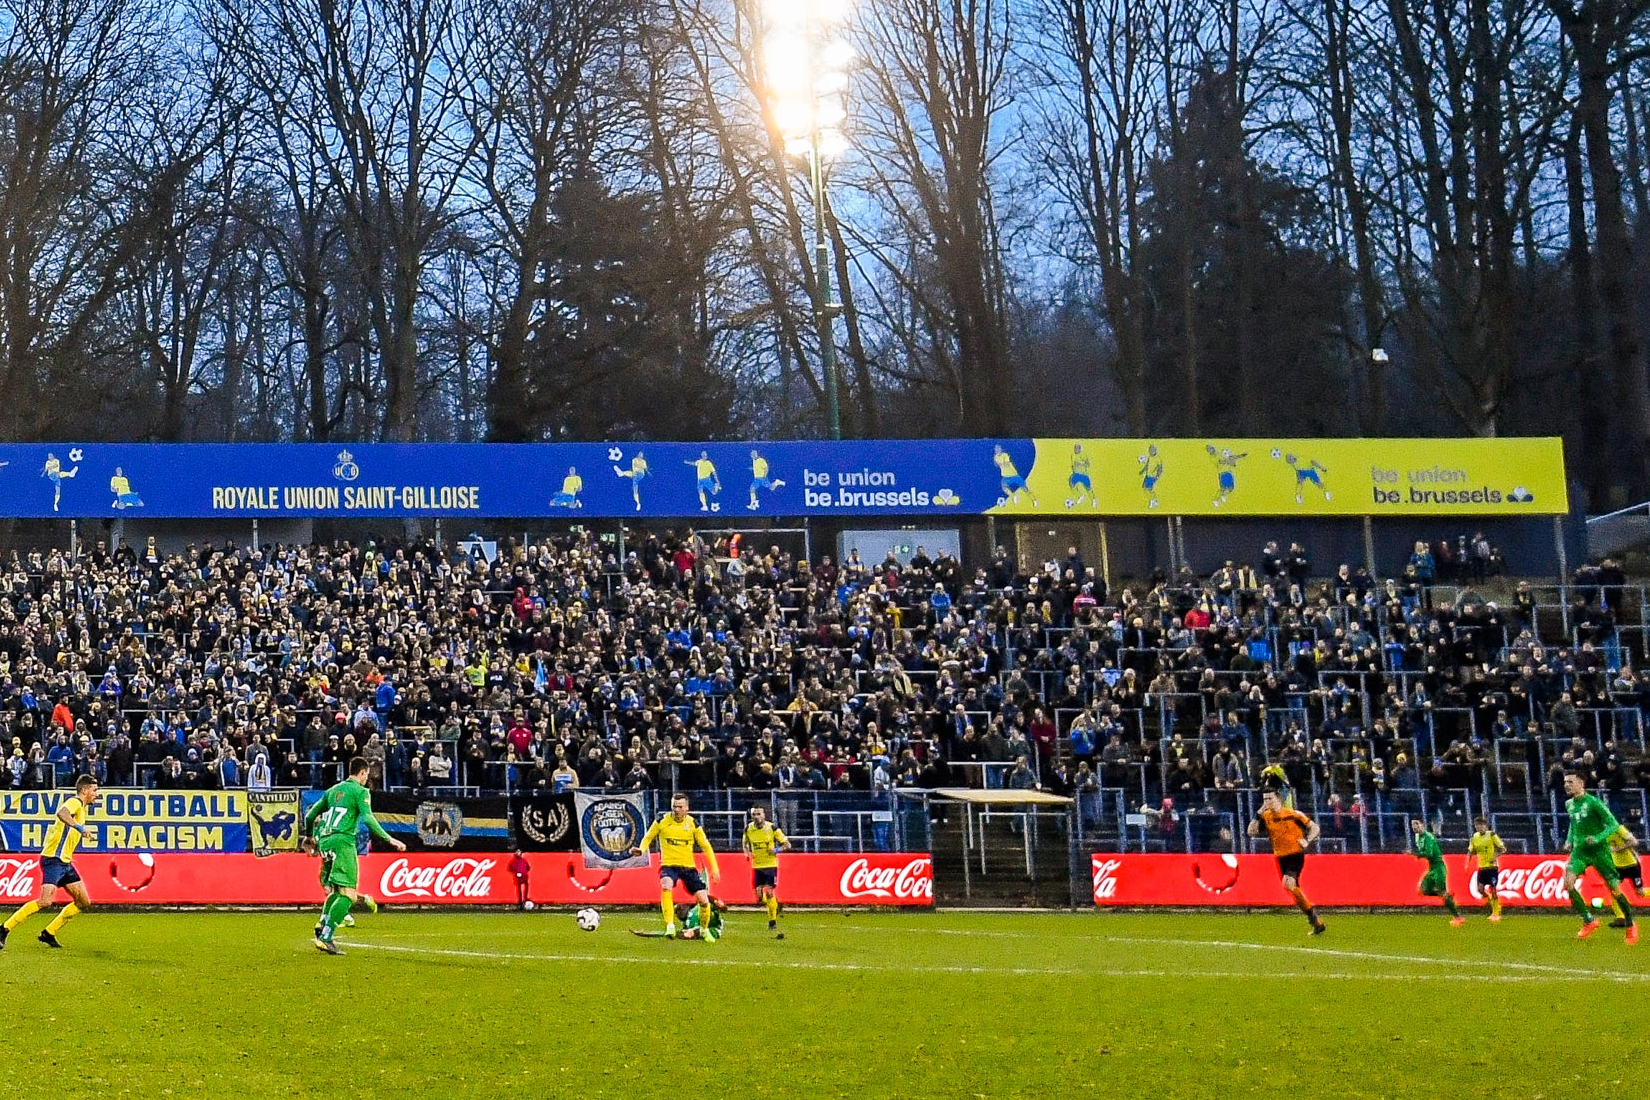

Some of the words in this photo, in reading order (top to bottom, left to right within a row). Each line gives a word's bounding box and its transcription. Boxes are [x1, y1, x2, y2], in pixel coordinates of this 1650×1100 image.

[803, 468, 830, 486] be
[838, 468, 896, 486] union
[1372, 465, 1398, 483] be
[1408, 465, 1467, 483] union
[212, 486, 279, 510] ROYALE
[284, 486, 339, 510] UNION
[343, 486, 480, 510] SAINT-GILLOISE
[88, 793, 242, 817] FOOTBALL
[324, 806, 348, 828] 17
[21, 823, 99, 849] HE
[106, 825, 223, 850] RACISM
[380, 858, 497, 897] Coca-Cola
